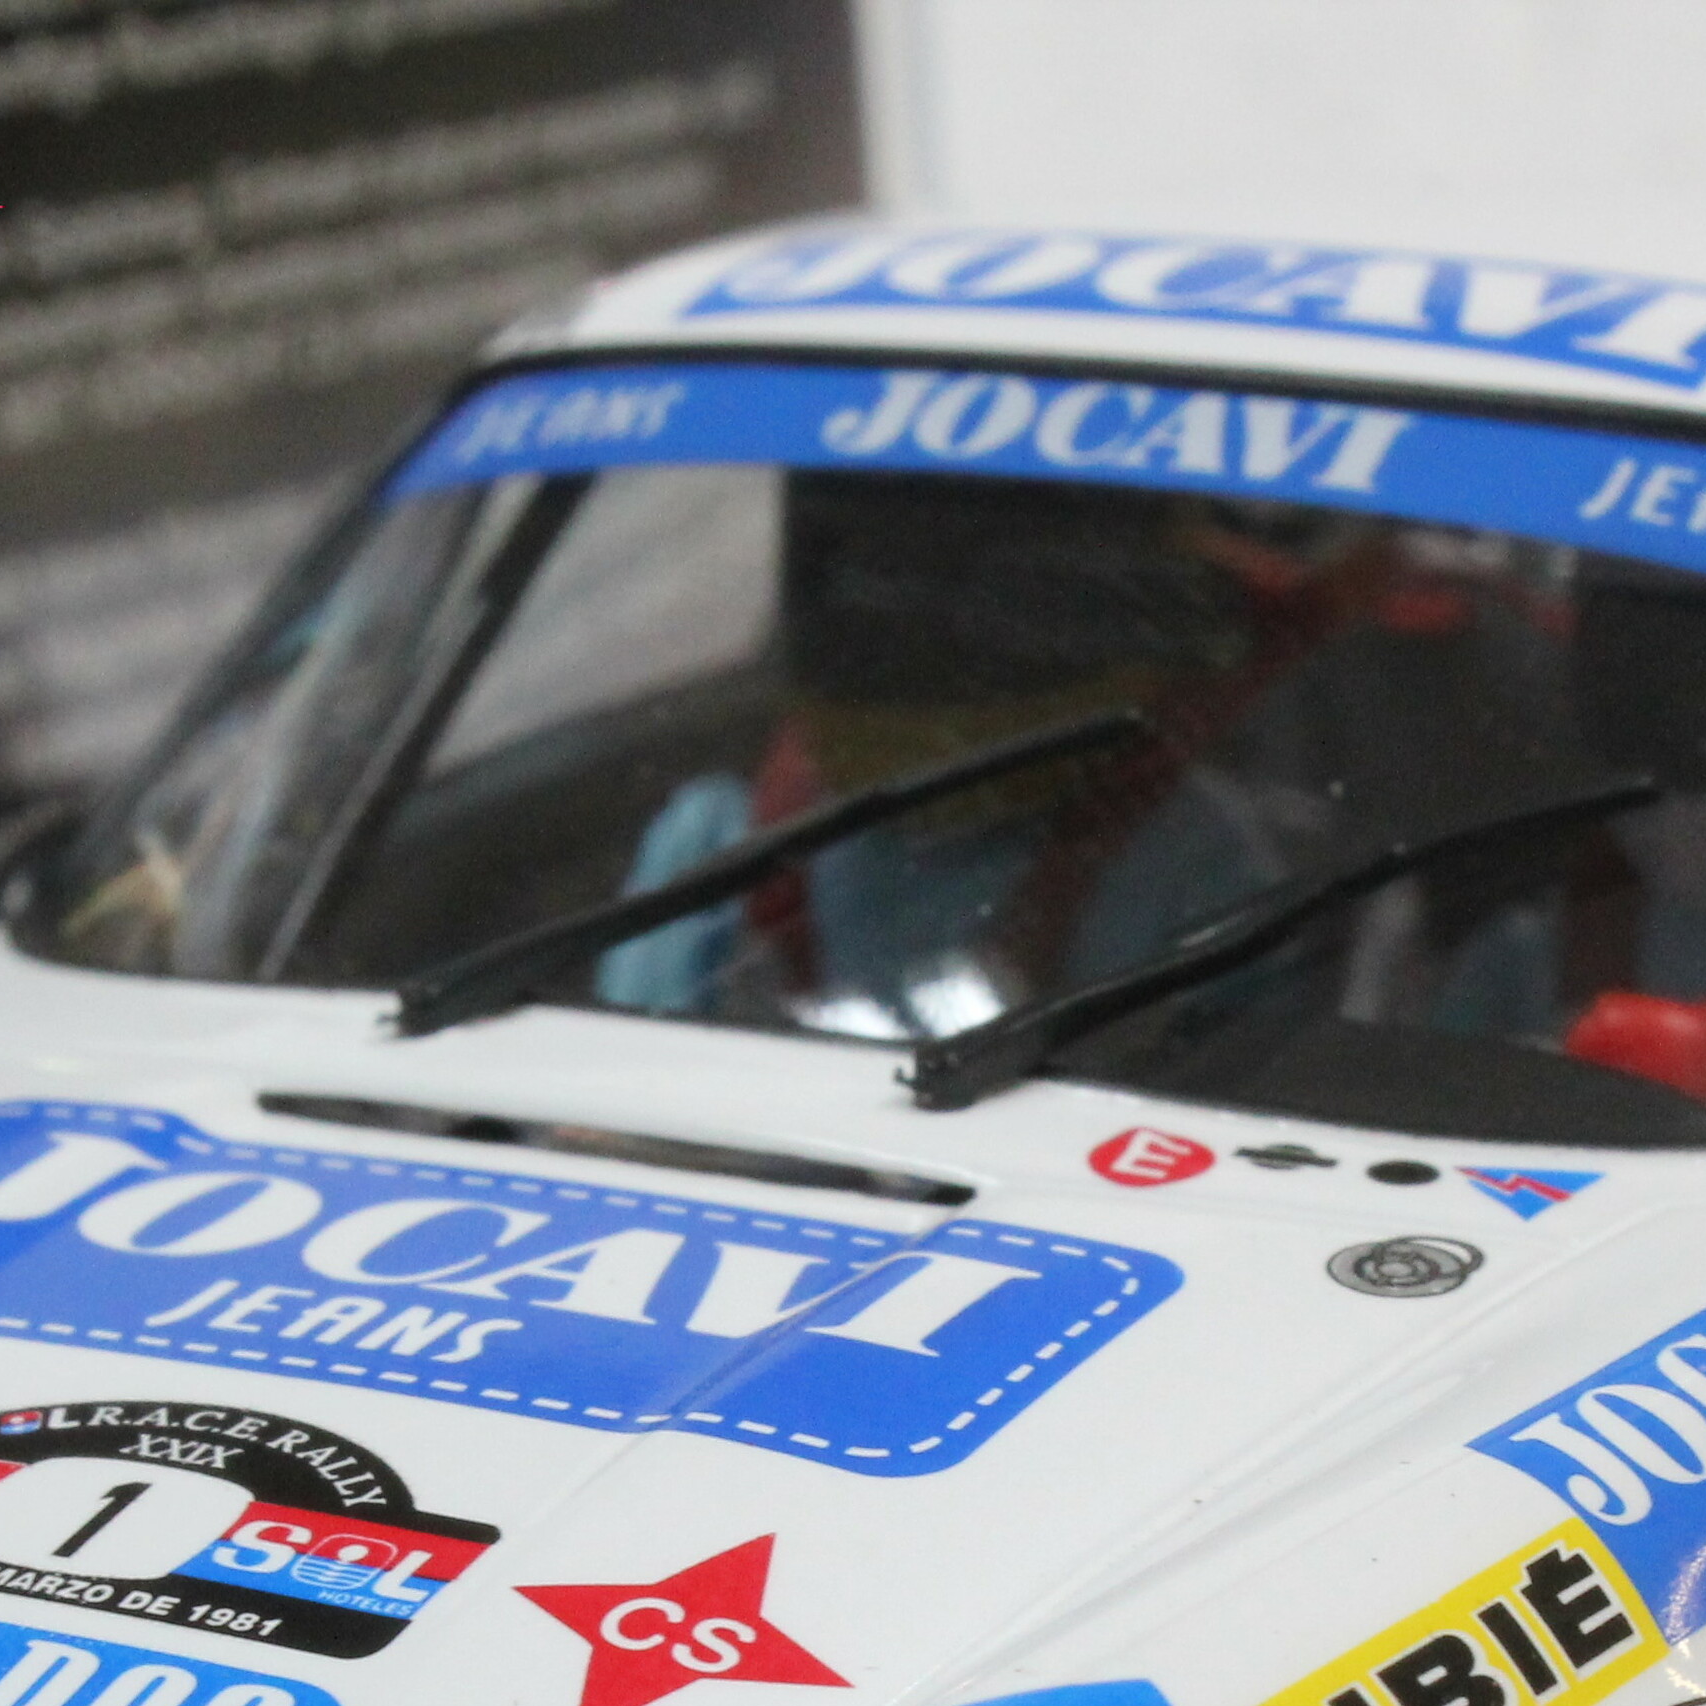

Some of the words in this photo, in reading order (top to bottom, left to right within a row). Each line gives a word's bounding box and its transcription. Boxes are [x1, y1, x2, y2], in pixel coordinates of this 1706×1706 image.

[820, 369, 1418, 494] JOCAVI
[146, 1279, 526, 1364] JEANS
[89, 1405, 260, 1442] R.A.C.E.
[271, 1428, 387, 1509] RALLY
[119, 1433, 245, 1469] XXIX
[52, 1481, 152, 1558] 1
[210, 1520, 436, 1603] SOL
[118, 1588, 183, 1618] DE
[188, 1603, 284, 1637] 1981
[317, 1587, 415, 1619] HOTELES
[598, 1596, 757, 1674] CS
